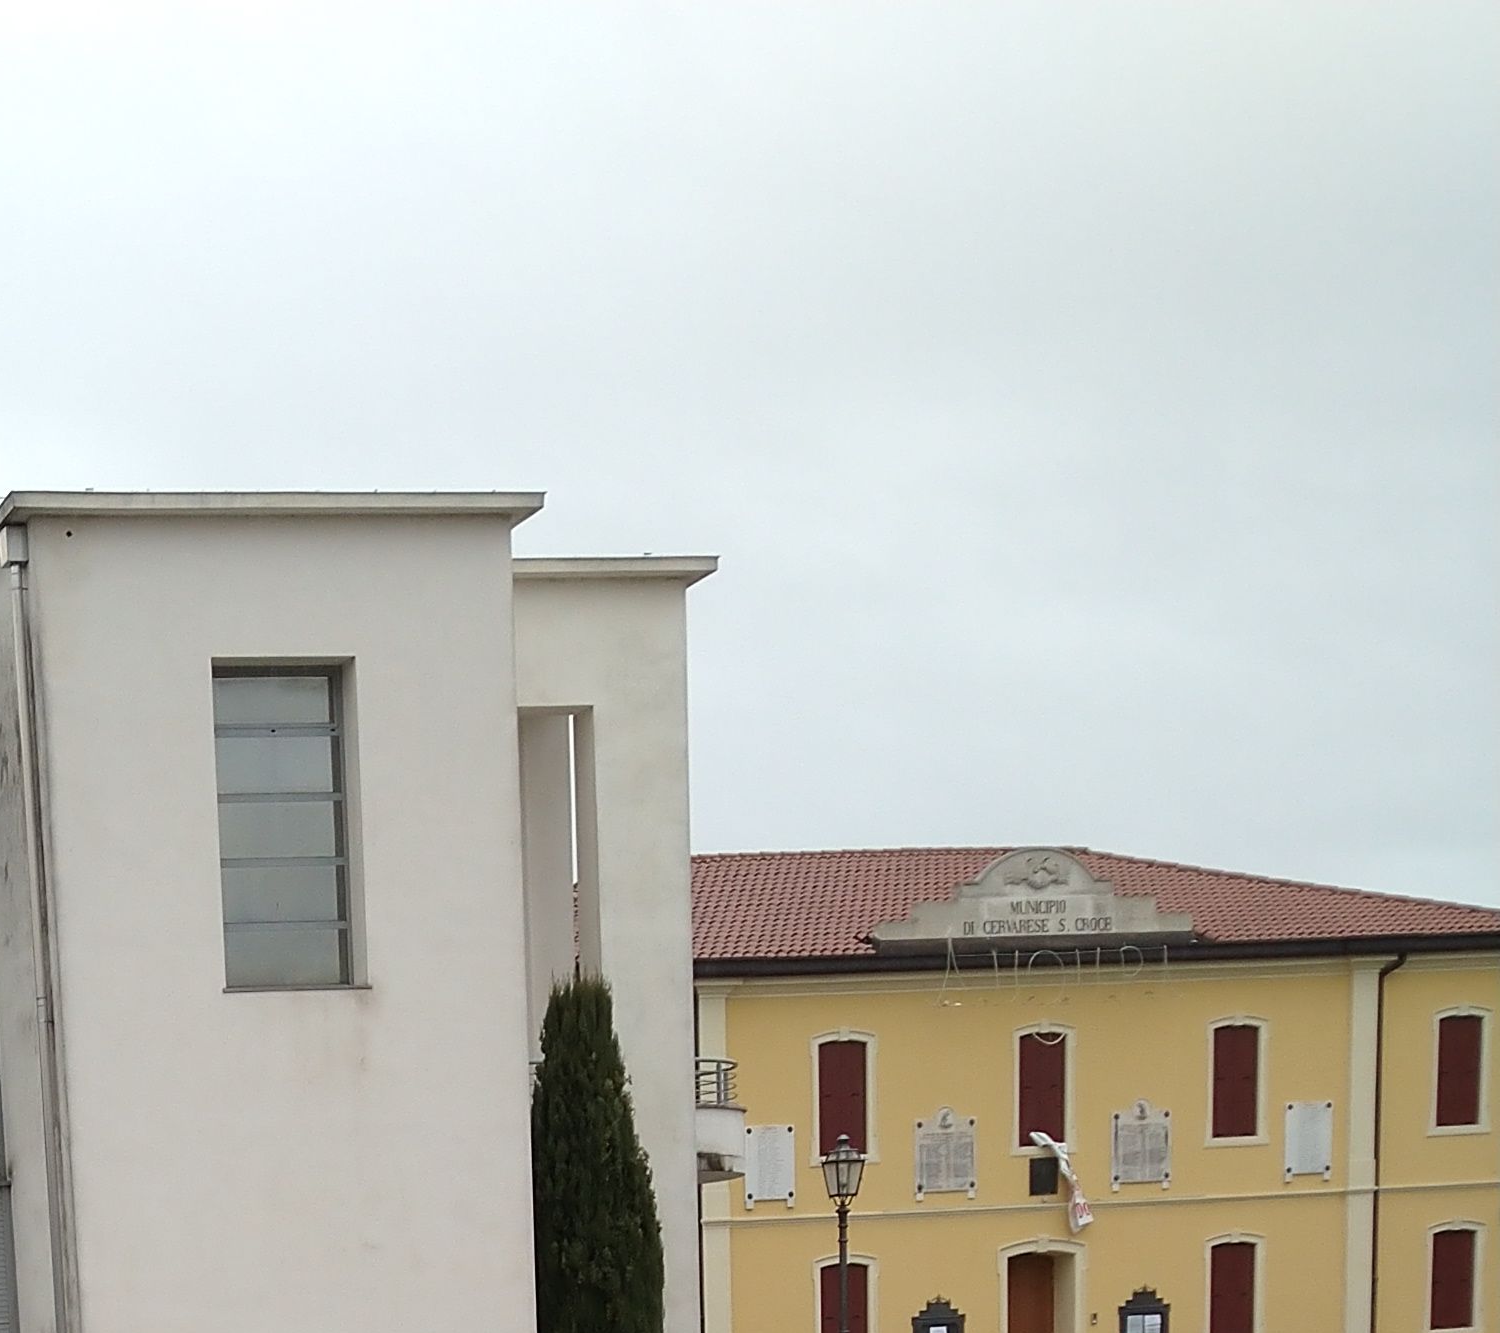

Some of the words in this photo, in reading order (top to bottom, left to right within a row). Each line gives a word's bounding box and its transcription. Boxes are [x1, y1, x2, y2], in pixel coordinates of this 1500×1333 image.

[1010, 899, 1066, 915] MUNICIPIO
[963, 920, 975, 936] DI
[983, 918, 1049, 935] CERVARESE
[1074, 916, 1113, 932] CROCE
